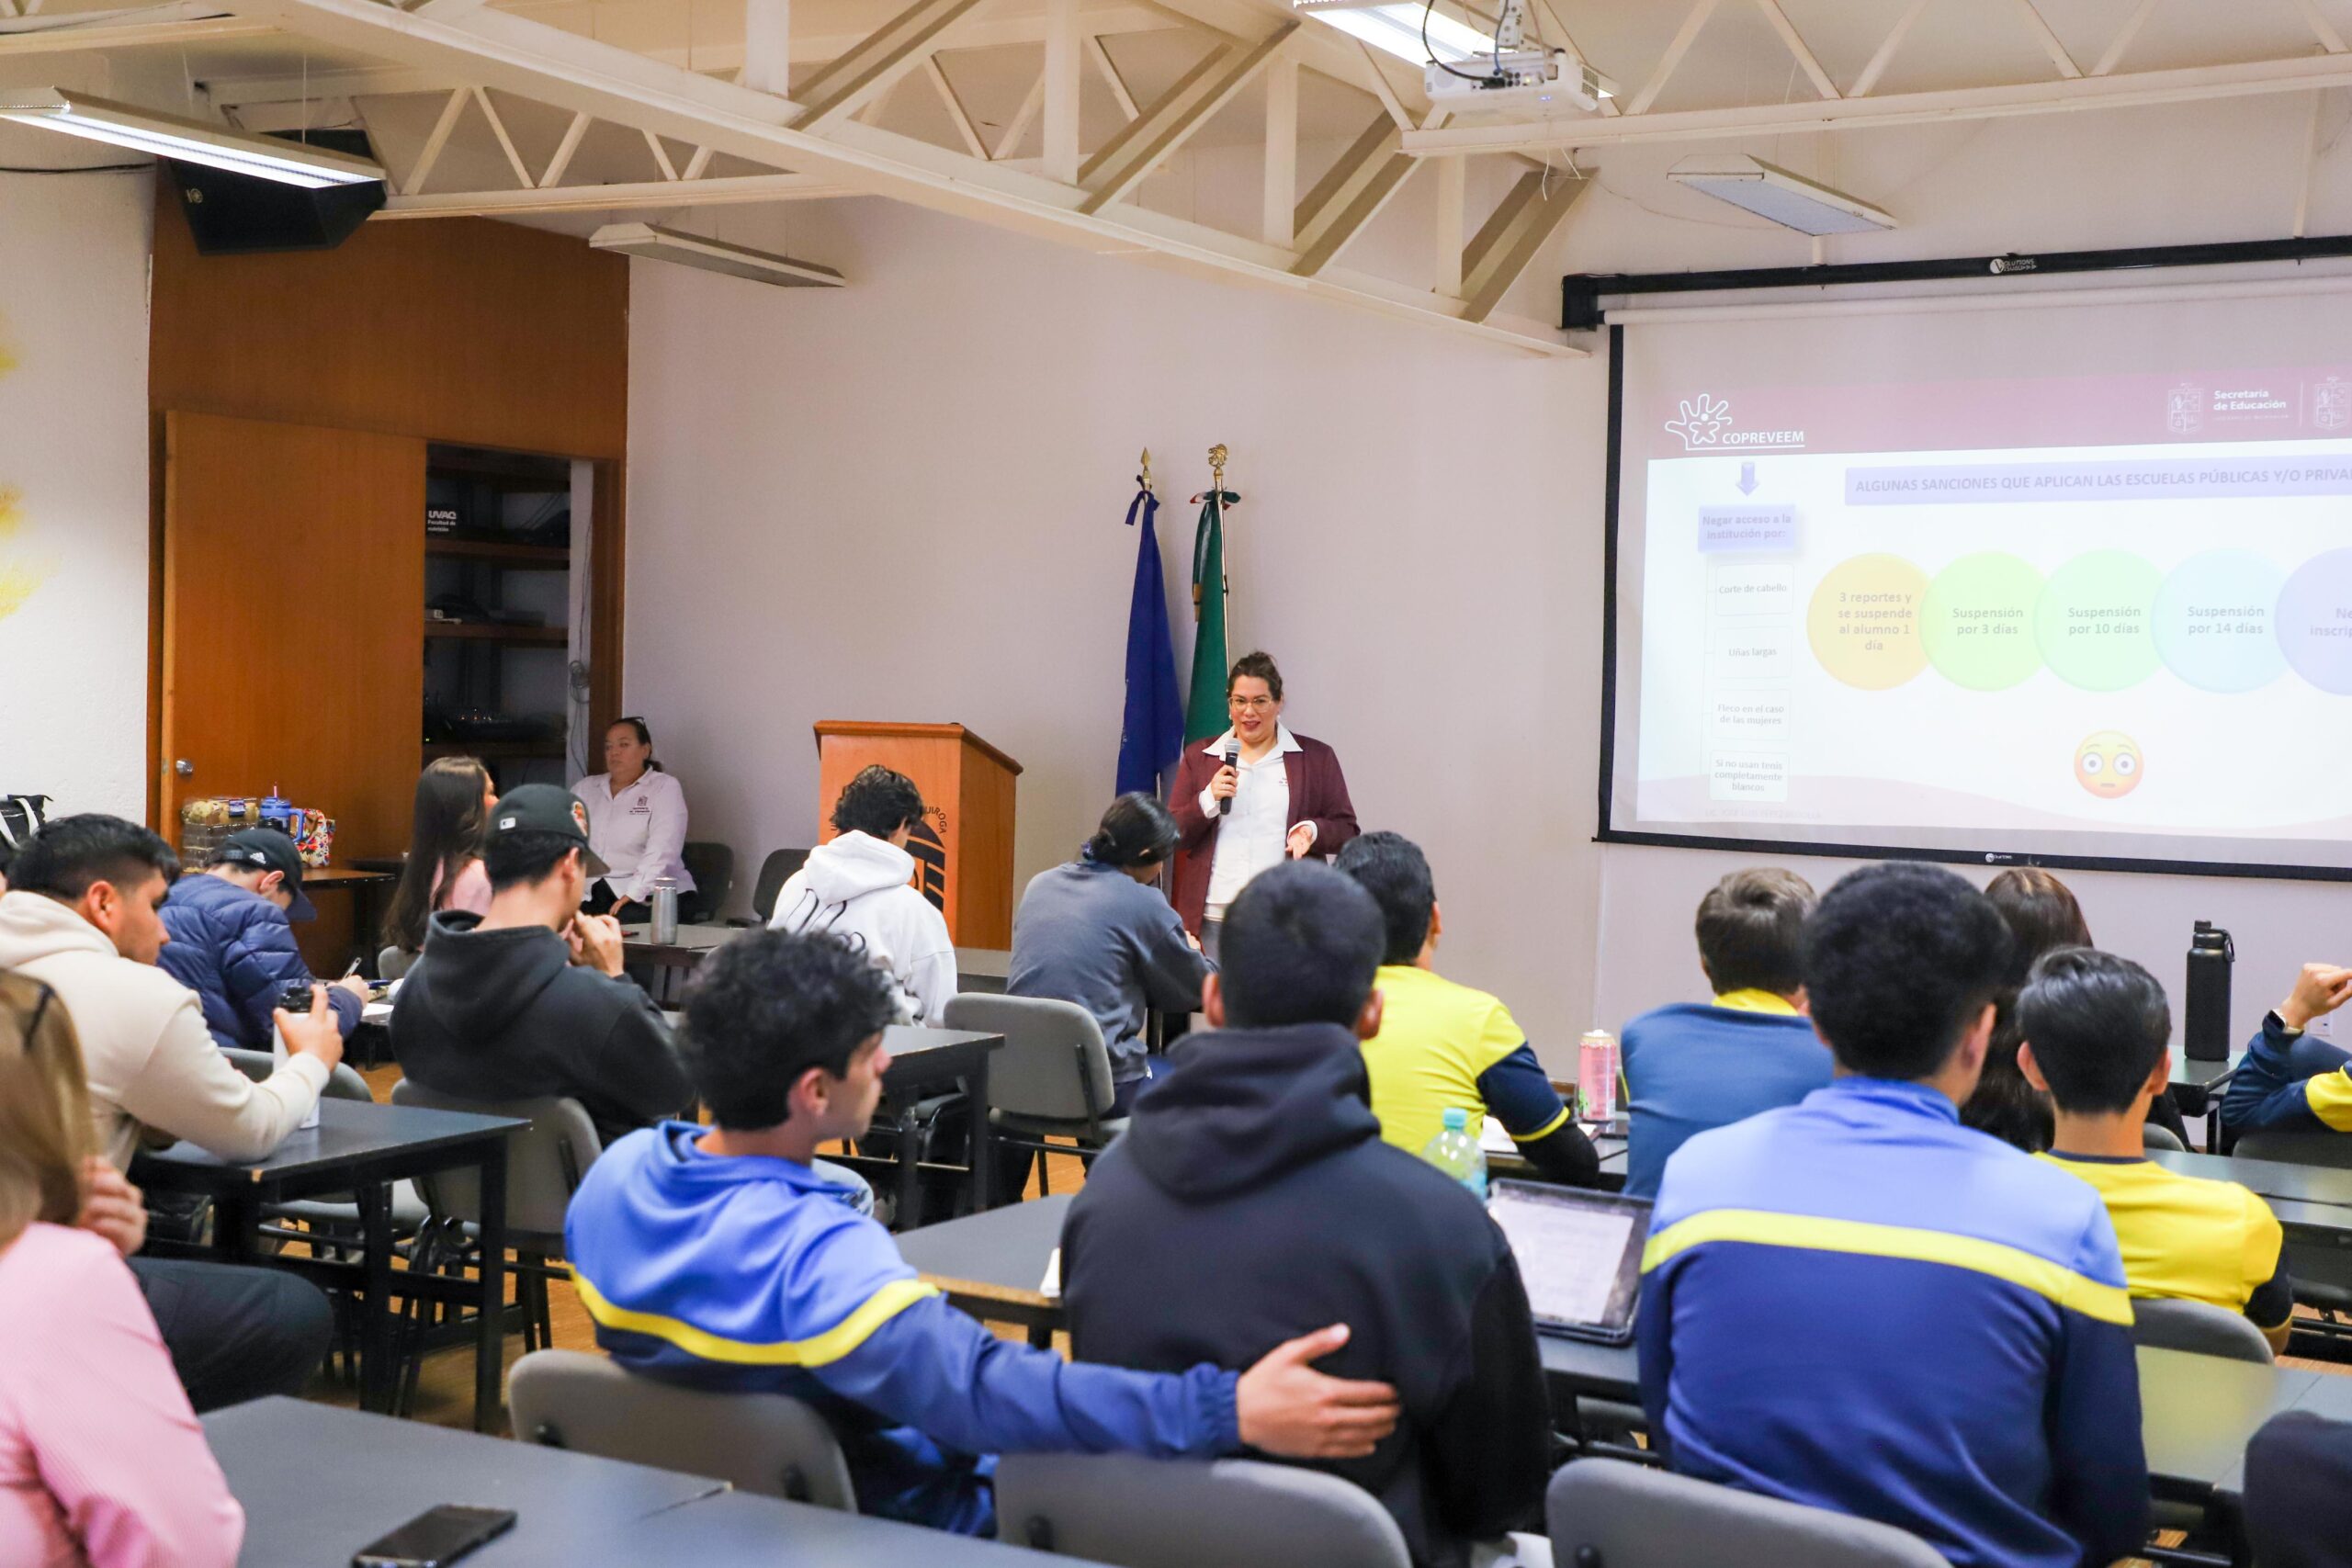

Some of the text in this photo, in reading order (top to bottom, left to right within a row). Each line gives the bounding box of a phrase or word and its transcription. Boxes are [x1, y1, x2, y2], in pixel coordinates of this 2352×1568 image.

[2213, 400, 2287, 412] de Educación
[1722, 430, 1805, 445] COPREVEEM
[1855, 479, 1918, 492] ALGUNAS
[1921, 478, 1997, 491] SANCIONES
[2000, 476, 2030, 490] QUE
[2034, 474, 2094, 489] APLICAN
[2098, 473, 2121, 487] LAS
[2125, 471, 2195, 486] ESCUELAS
[2199, 468, 2269, 484] PÚBLICAS
[2273, 468, 2301, 485] Y/O
[1702, 513, 1792, 527] Negar acceso a la
[1707, 527, 1761, 540] institución
[1719, 583, 1787, 594] Corte de cabello
[1838, 592, 1912, 606] 3 reportes y
[1838, 607, 1913, 621] se suspende
[1952, 606, 2024, 620] Suspensión
[2067, 605, 2142, 619] Suspensión
[2187, 605, 2266, 619] Suspensión
[1839, 623, 1910, 635] al alumno 1
[1956, 623, 2018, 637] por 3 días
[2068, 622, 2141, 637] por 10 días
[2188, 622, 2264, 637] por 14 días
[1864, 639, 1883, 651] día
[1728, 647, 1778, 658] Uñas largas
[1717, 704, 1740, 714] Fleco
[1755, 705, 1764, 713] el
[1765, 705, 1785, 714] caso
[1719, 716, 1782, 727] de las mujeres
[1715, 760, 1724, 768] Si
[1738, 761, 1759, 770] usan
[1761, 761, 1782, 771] tenis
[1714, 772, 1783, 782] completamente
[1732, 782, 1765, 792] blancos
